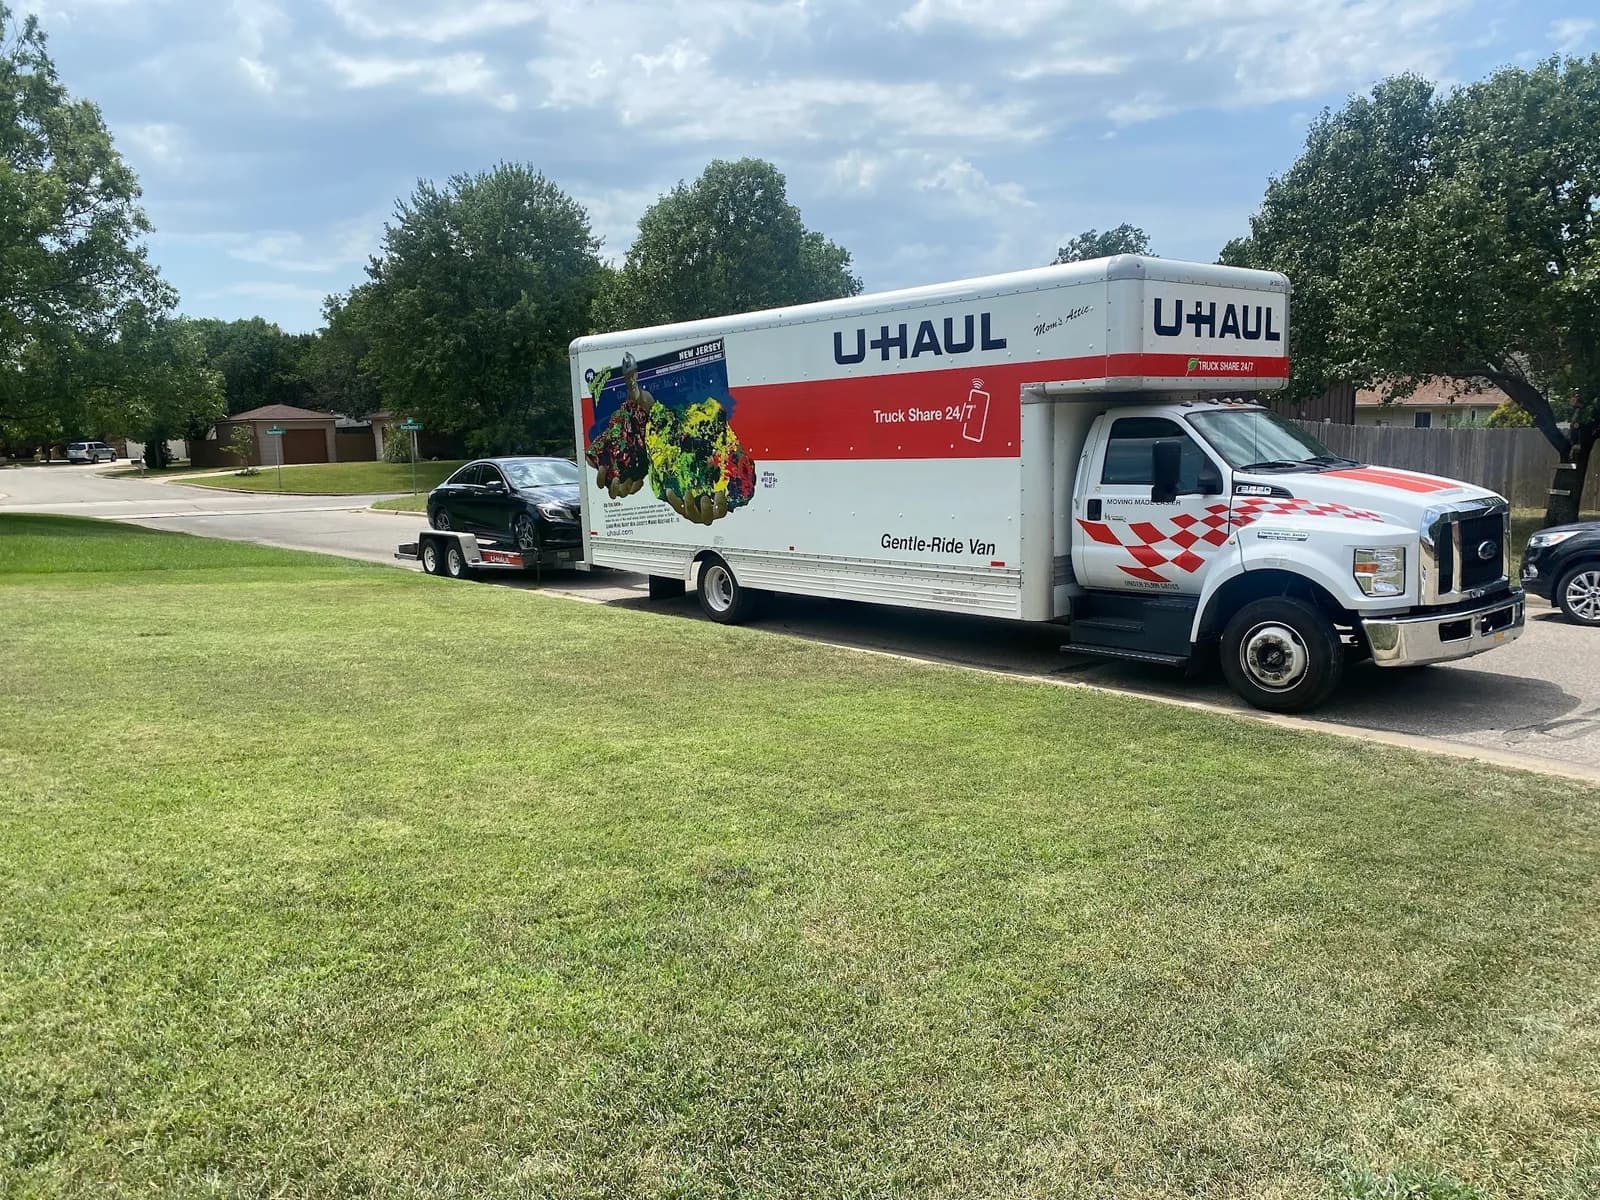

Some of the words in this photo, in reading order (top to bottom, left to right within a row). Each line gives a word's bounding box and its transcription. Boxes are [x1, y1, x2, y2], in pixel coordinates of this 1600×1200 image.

[1033, 317, 1063, 337] Mom's
[1065, 306, 1089, 324] Attic
[1154, 298, 1280, 341] U-HAUL
[833, 312, 1007, 365] U-HAUL
[679, 348, 694, 361] NEW
[695, 341, 721, 356] JERSEY
[1199, 361, 1219, 371] TRUCK
[1220, 361, 1241, 371] SHARE
[1241, 362, 1254, 372] 24/7
[873, 409, 905, 423] Truck
[908, 407, 942, 422] Share
[945, 402, 974, 422] 24/7
[606, 529, 634, 537] uhaul.com
[881, 533, 964, 554] Gentle-Ride
[969, 538, 996, 556] Van
